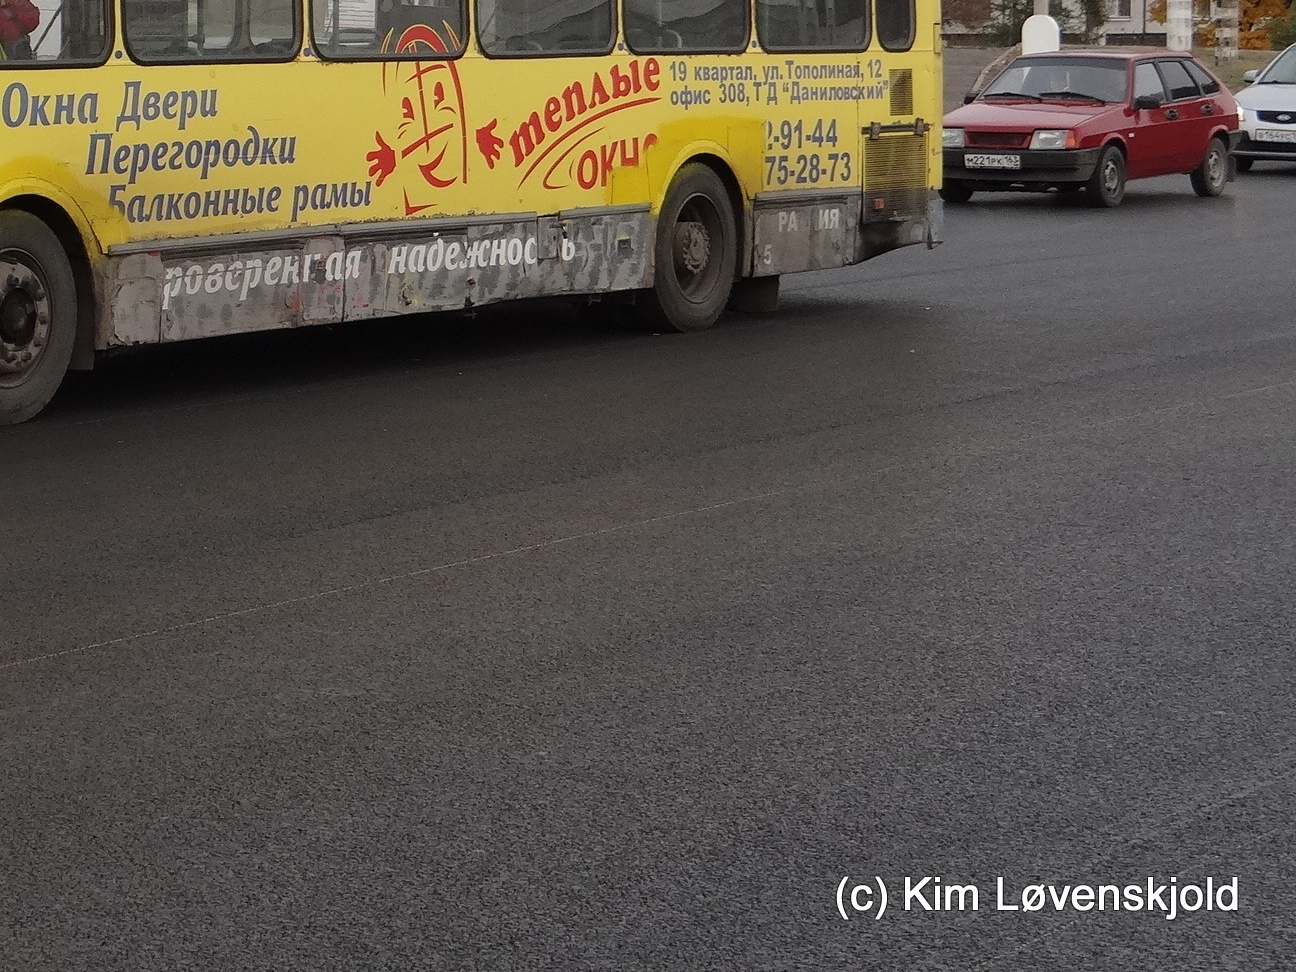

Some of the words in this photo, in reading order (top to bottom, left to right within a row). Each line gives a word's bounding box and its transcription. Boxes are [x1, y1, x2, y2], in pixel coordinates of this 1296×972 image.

[669, 61, 687, 81] 19
[694, 65, 757, 84] квартал,
[867, 59, 882, 78] 12
[2, 82, 99, 127] Окна
[116, 81, 218, 131] Двери
[509, 57, 661, 168] теплые
[670, 85, 711, 110] офис
[718, 83, 750, 107] 308,
[85, 126, 296, 185] Перегородки
[765, 152, 851, 185] 75-28-73
[109, 183, 280, 224] Балконные
[292, 181, 372, 222] рамы
